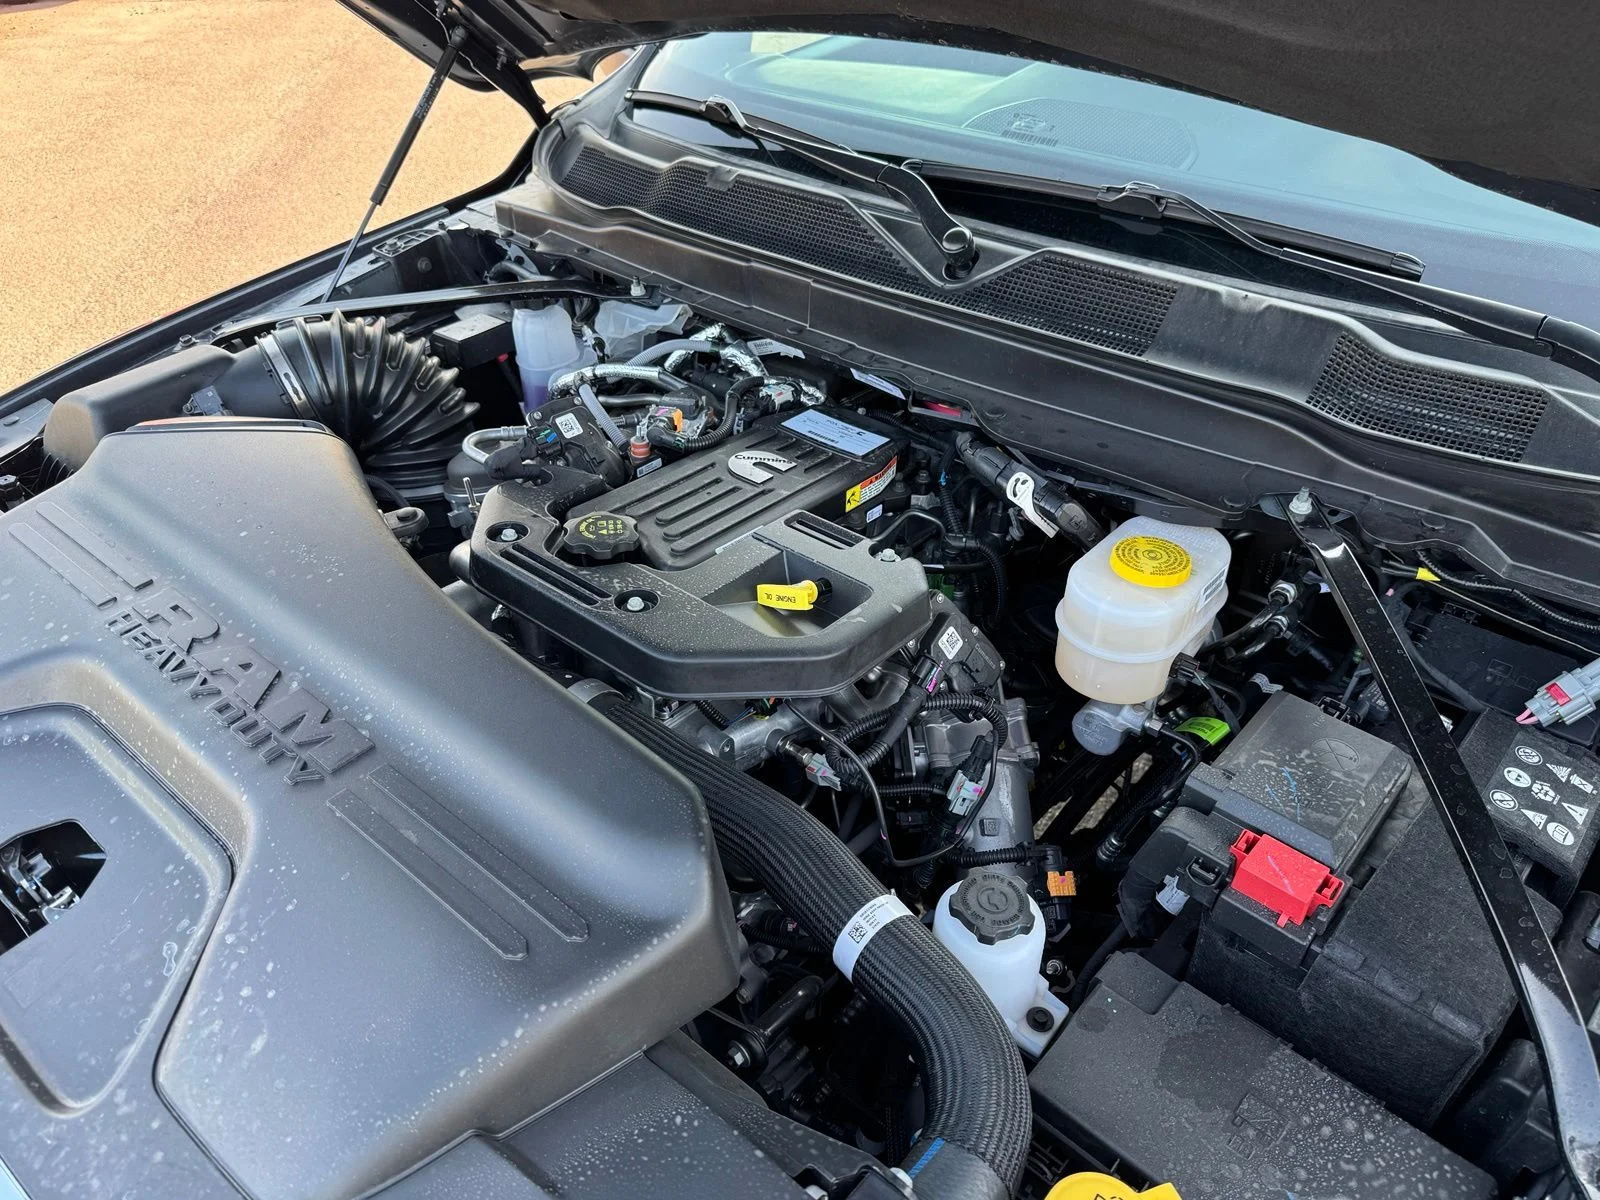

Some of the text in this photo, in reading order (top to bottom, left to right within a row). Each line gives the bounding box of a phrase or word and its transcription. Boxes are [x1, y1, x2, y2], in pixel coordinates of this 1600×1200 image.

[735, 454, 793, 464] Cummins
[775, 594, 796, 603] ENGINE
[104, 609, 325, 786] HEAVY DUTY
[132, 586, 376, 774] RAM
